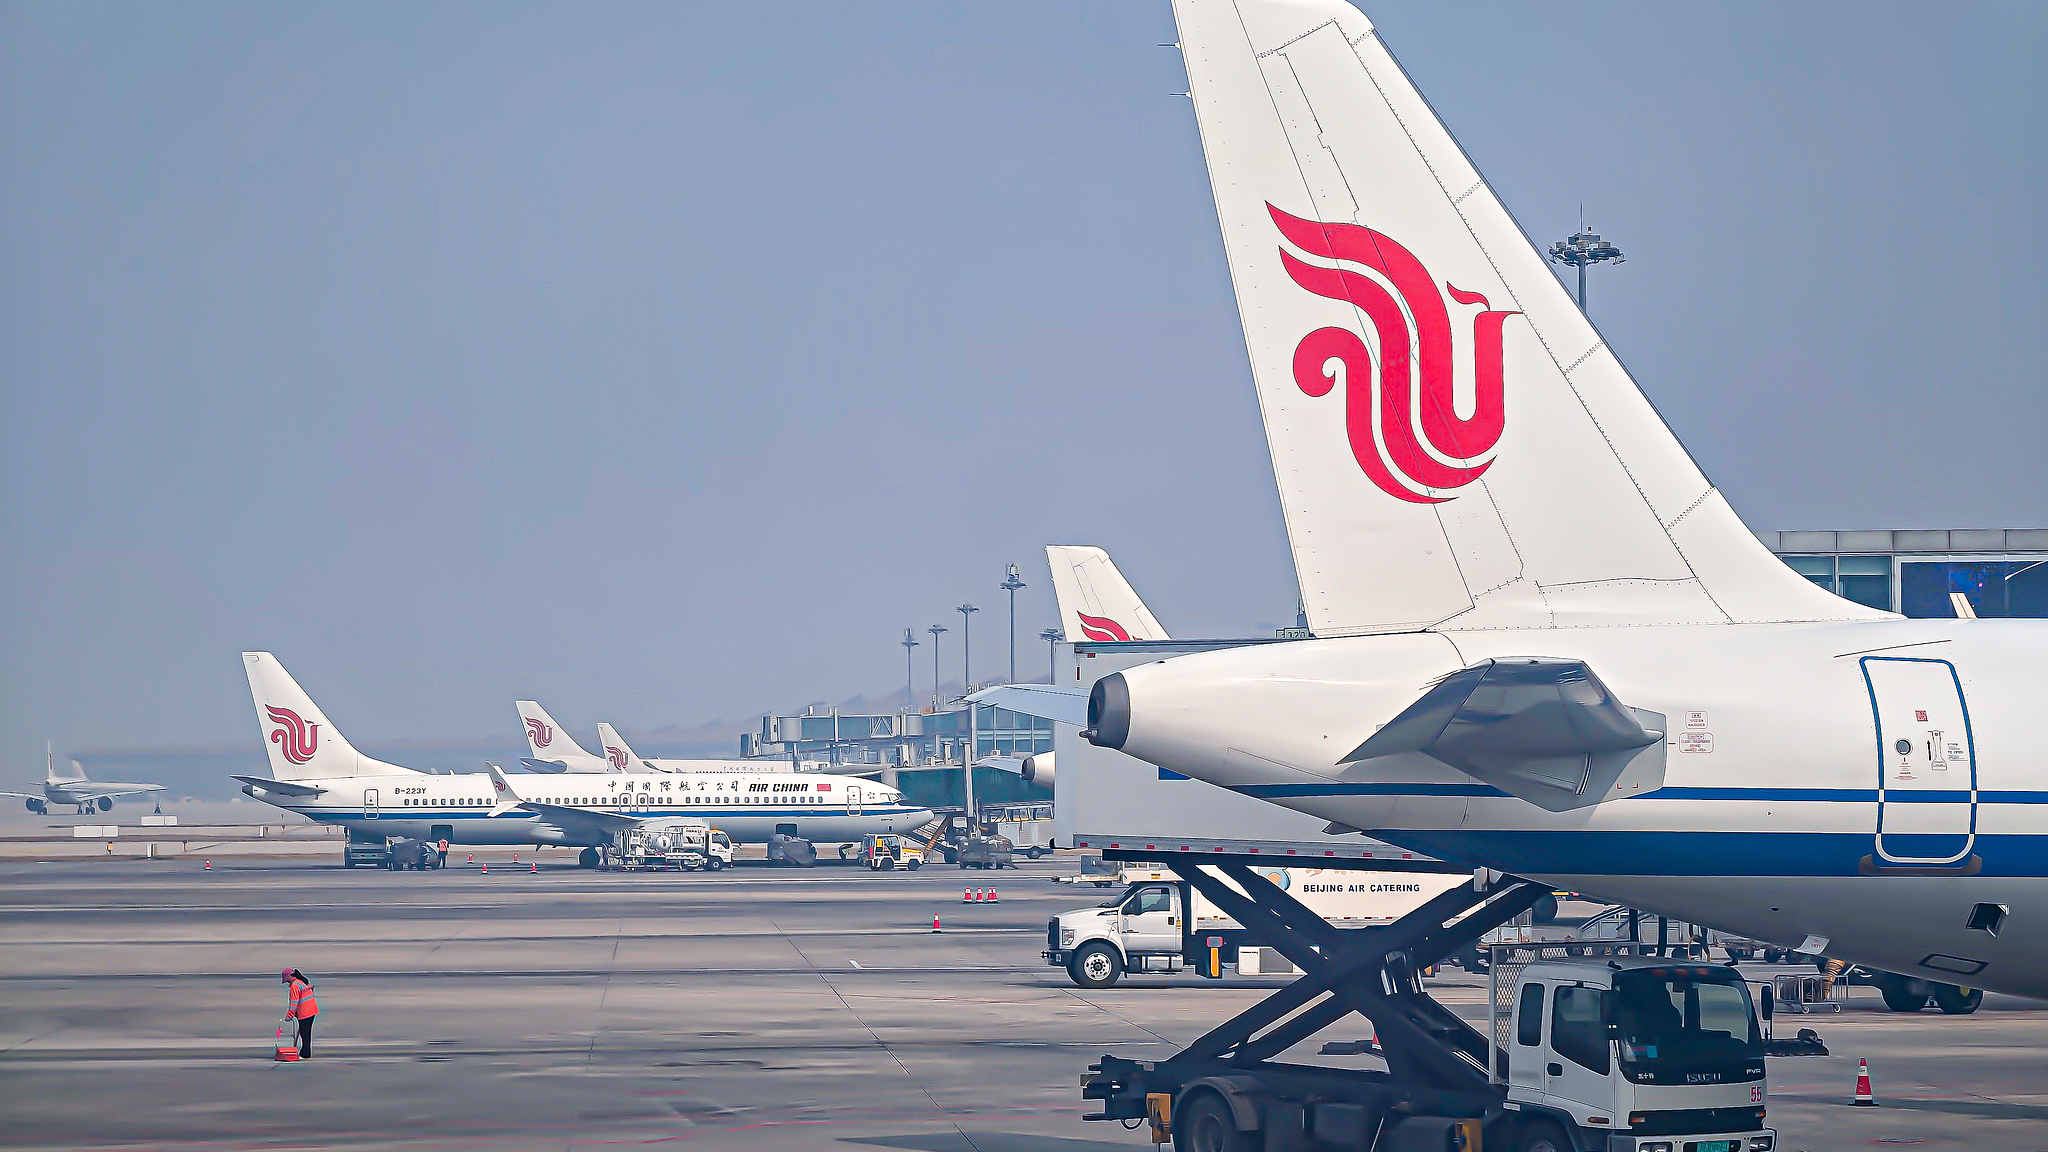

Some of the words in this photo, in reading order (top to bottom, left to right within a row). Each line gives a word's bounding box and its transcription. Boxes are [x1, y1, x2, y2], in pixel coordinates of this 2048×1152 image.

[394, 787, 427, 795] B-223Y
[748, 783, 769, 792] AIR
[772, 783, 809, 792] CHINA
[1303, 884, 1343, 892] BEIJING
[1348, 884, 1365, 892] AIR
[1370, 884, 1420, 892] CATERING
[1686, 1073, 1720, 1082] ISUZU
[1750, 1086, 1762, 1102] 55
